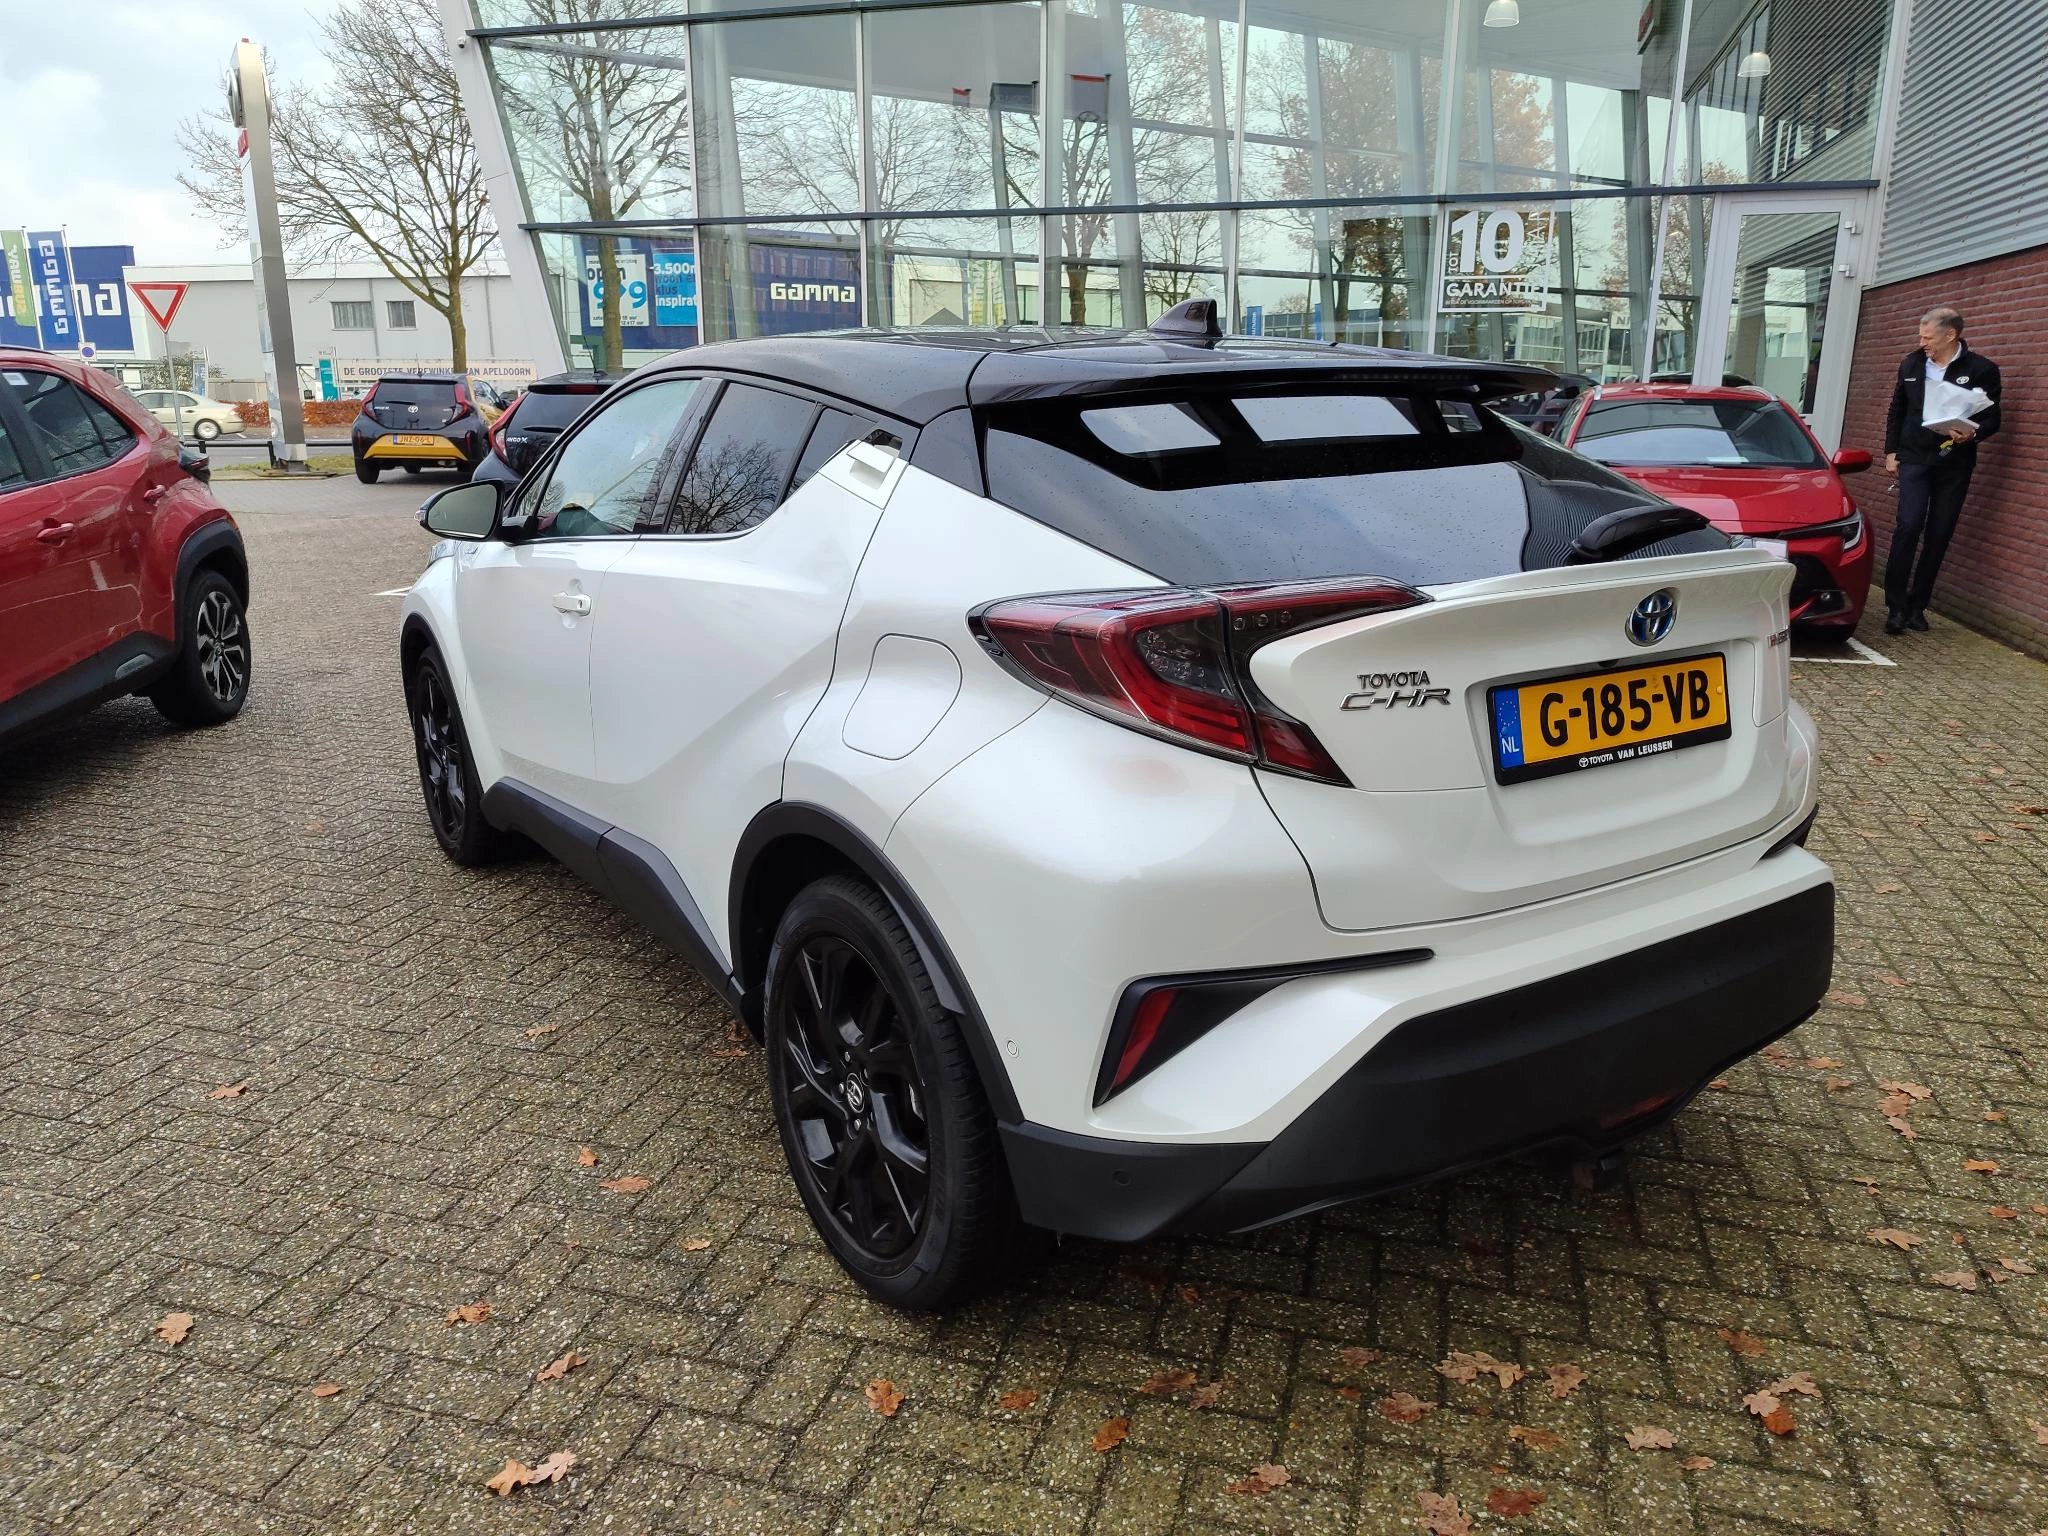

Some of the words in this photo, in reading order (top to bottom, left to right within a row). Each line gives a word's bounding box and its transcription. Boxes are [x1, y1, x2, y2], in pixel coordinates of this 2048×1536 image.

[1451, 209, 1525, 273] 10
[588, 267, 626, 282] opn
[629, 280, 648, 309] 9
[1446, 281, 1541, 297] GARANTIE
[483, 367, 531, 376] APELDOORN
[1357, 670, 1430, 689] TOYOTA
[1340, 688, 1451, 711] C-HR
[1540, 670, 1710, 747] G-185-VB
[1501, 737, 1519, 754] NL
[1589, 753, 1613, 764] TOYOTA
[1617, 748, 1634, 759] VAN
[1638, 740, 1673, 755] LEUSSEN
